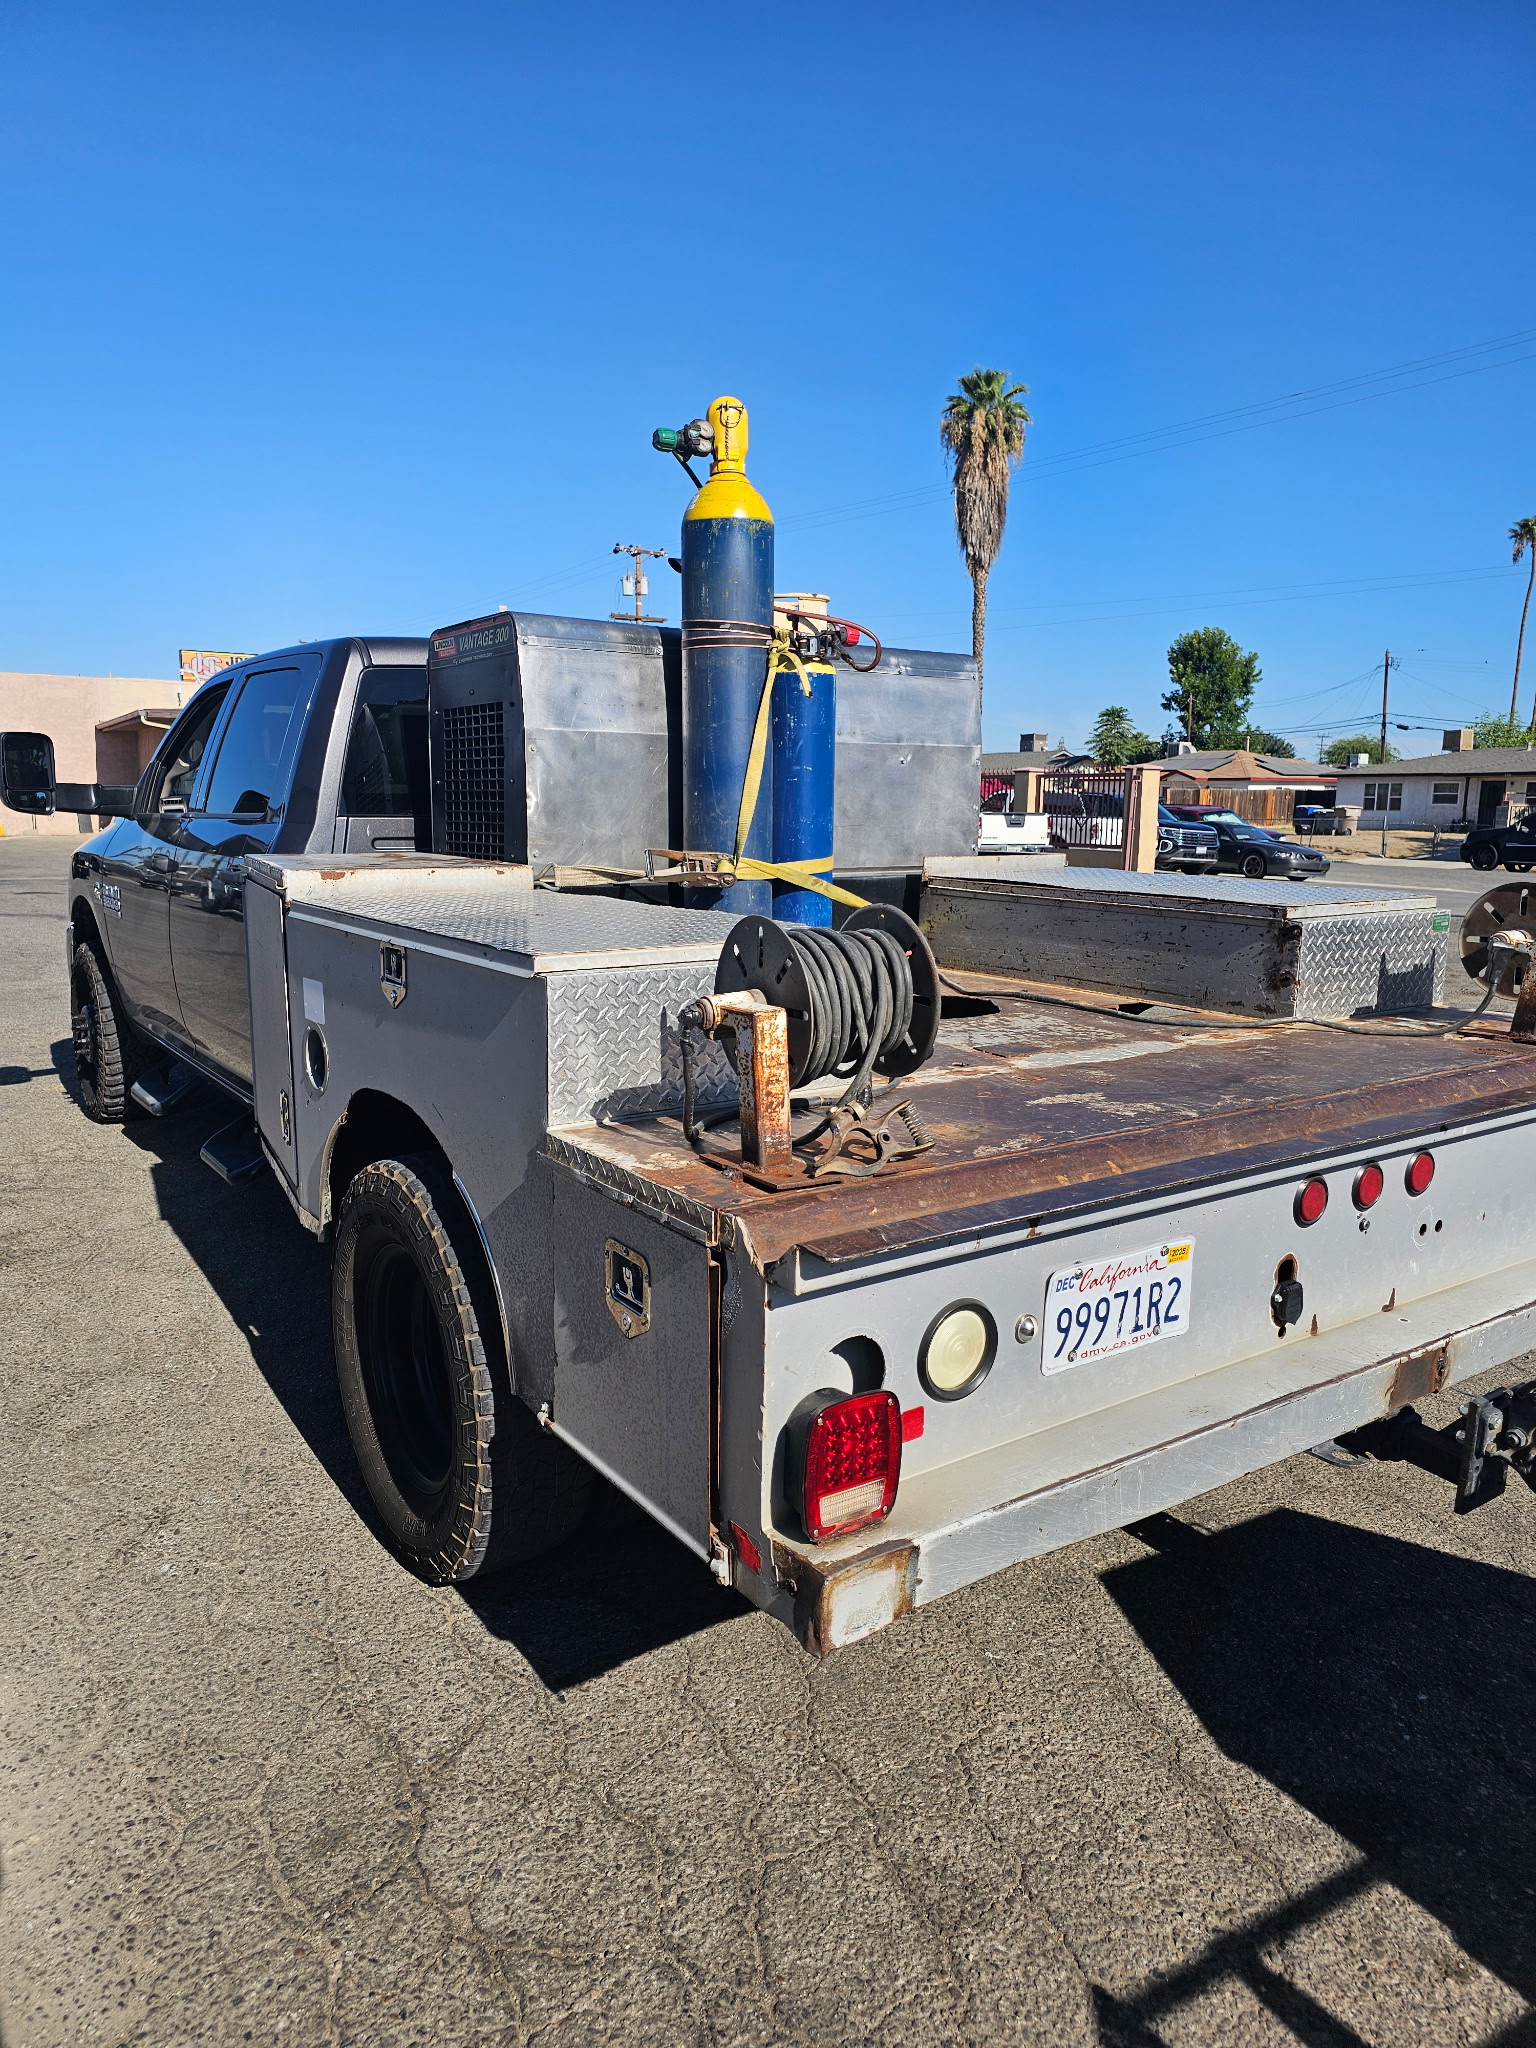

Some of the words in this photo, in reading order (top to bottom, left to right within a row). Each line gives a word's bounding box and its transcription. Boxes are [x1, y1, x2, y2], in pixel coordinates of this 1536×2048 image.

[460, 630, 494, 651] VANTAGE
[496, 626, 509, 643] 300
[1055, 1275, 1075, 1292] DEC
[1078, 1255, 1167, 1292] California
[1053, 1276, 1182, 1359] 99971R2
